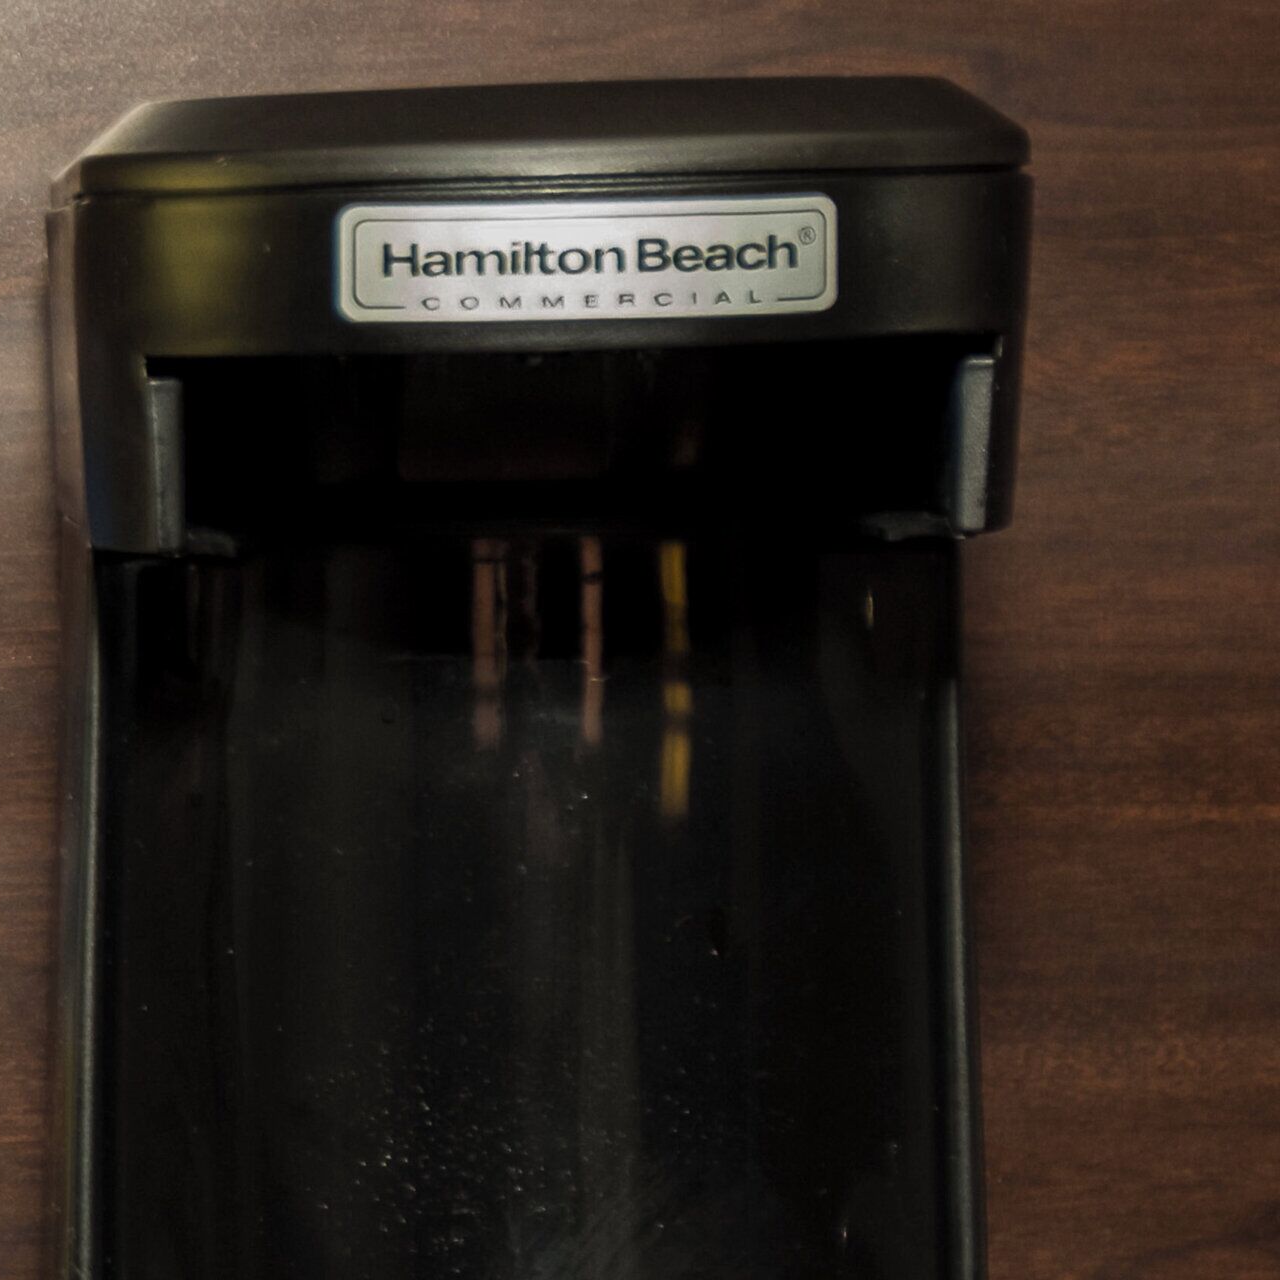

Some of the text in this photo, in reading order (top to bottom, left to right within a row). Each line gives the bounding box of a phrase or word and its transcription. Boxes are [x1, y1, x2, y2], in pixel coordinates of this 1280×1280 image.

[382, 233, 799, 279] Hamilton Beach
[420, 289, 764, 312] COMMERCIAL
